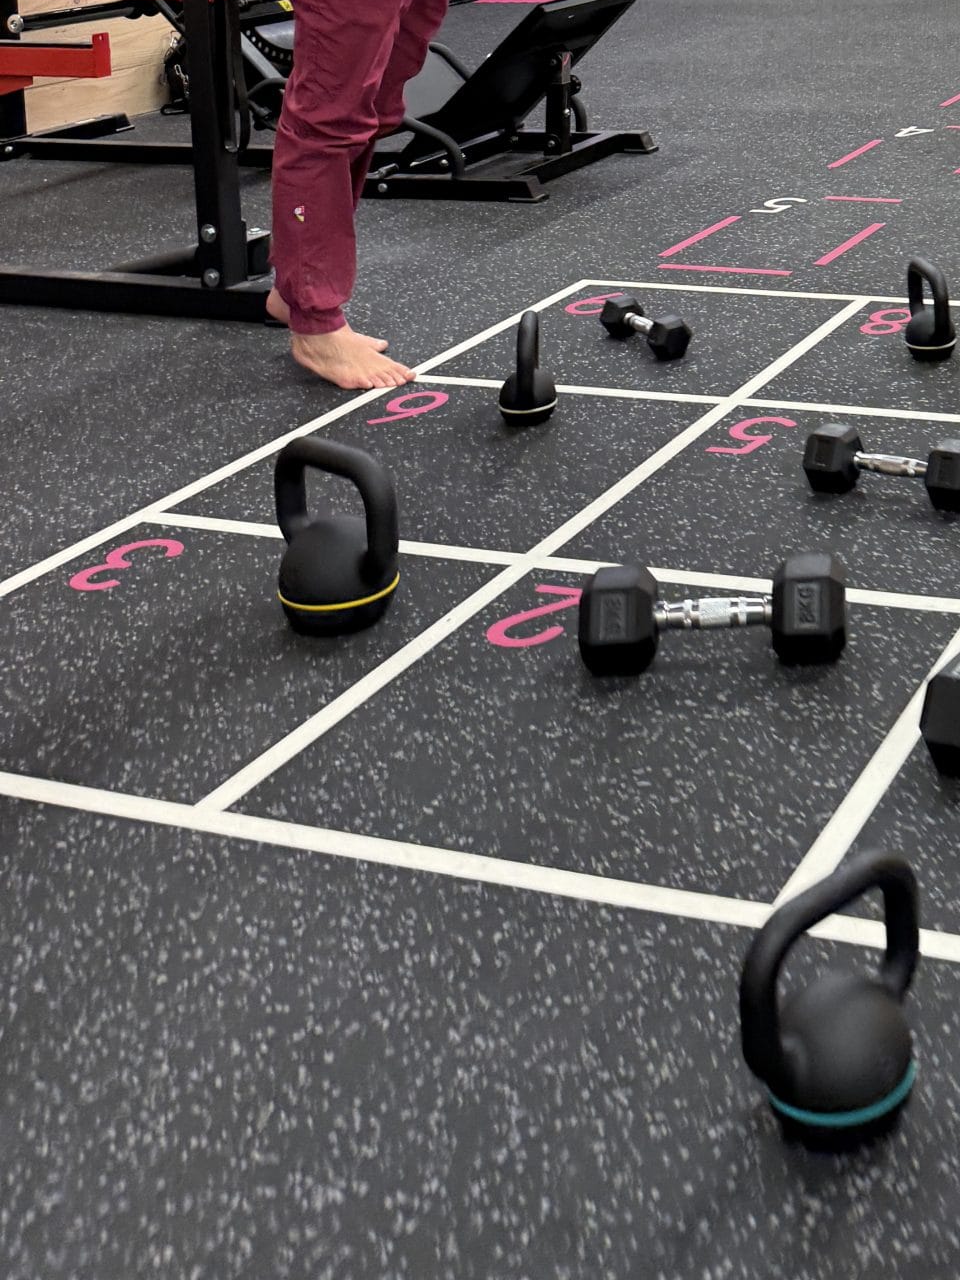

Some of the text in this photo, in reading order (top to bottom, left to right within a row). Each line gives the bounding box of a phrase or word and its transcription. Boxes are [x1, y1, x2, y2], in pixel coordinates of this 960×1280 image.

[895, 125, 934, 137] 4
[749, 197, 807, 213] 5
[859, 309, 912, 334] 8
[704, 417, 797, 454] 5
[69, 539, 184, 591] 3
[486, 584, 583, 647] 2
